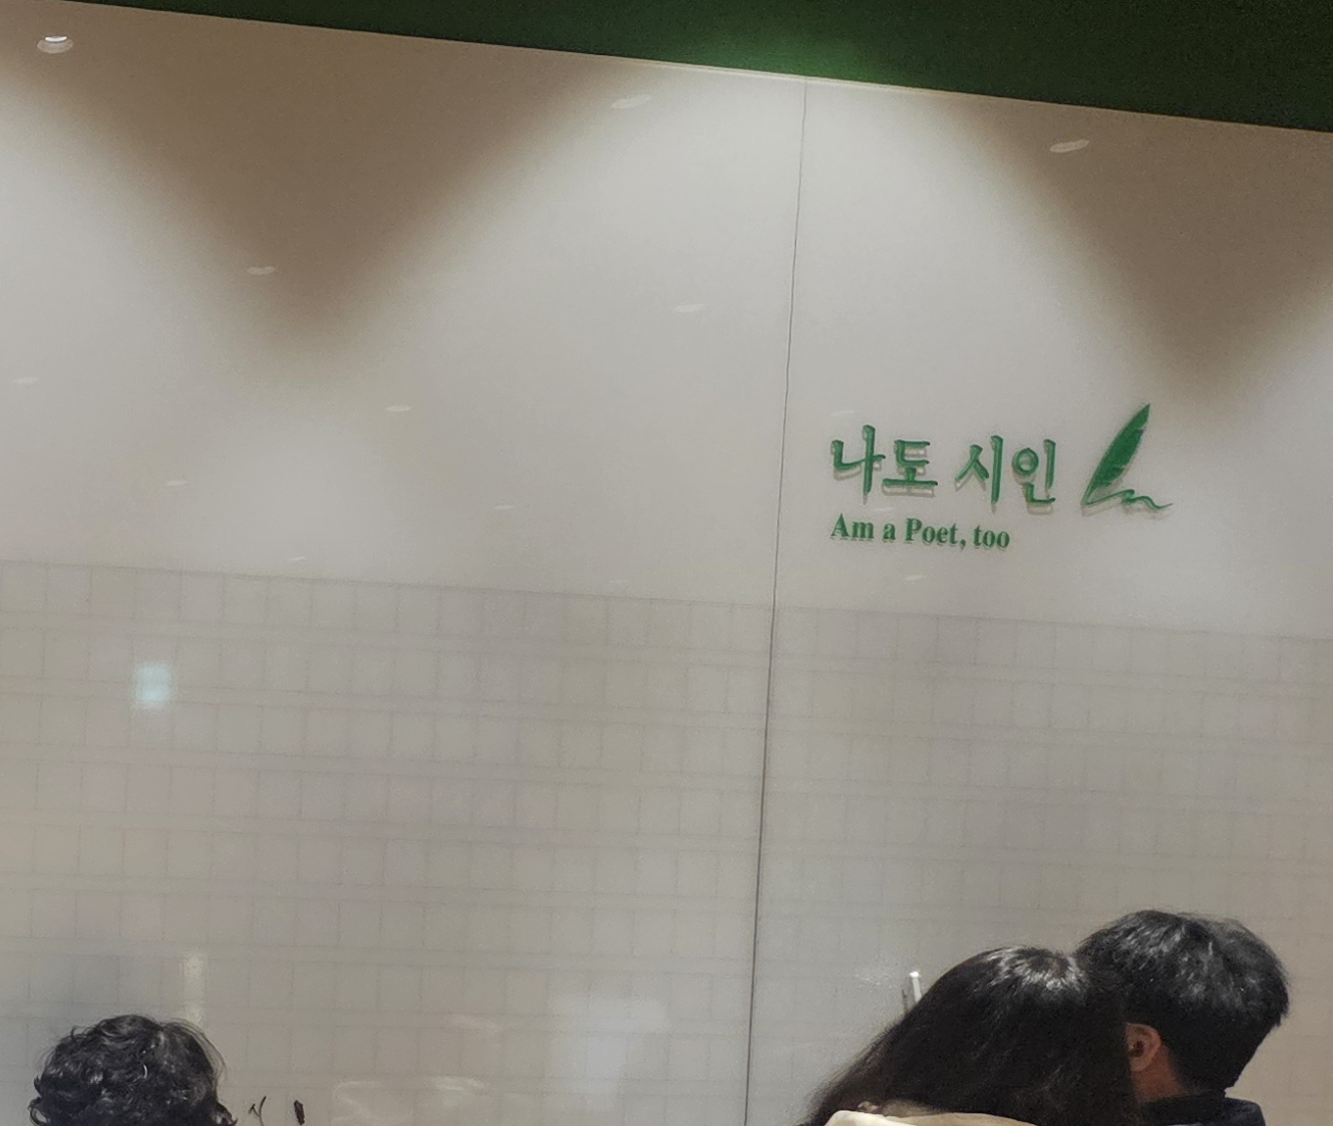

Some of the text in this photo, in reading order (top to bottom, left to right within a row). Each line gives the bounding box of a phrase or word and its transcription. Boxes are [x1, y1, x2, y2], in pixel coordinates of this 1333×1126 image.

[831, 424, 1057, 505] 나도 시인
[830, 513, 1010, 549] Am a Poet, too
